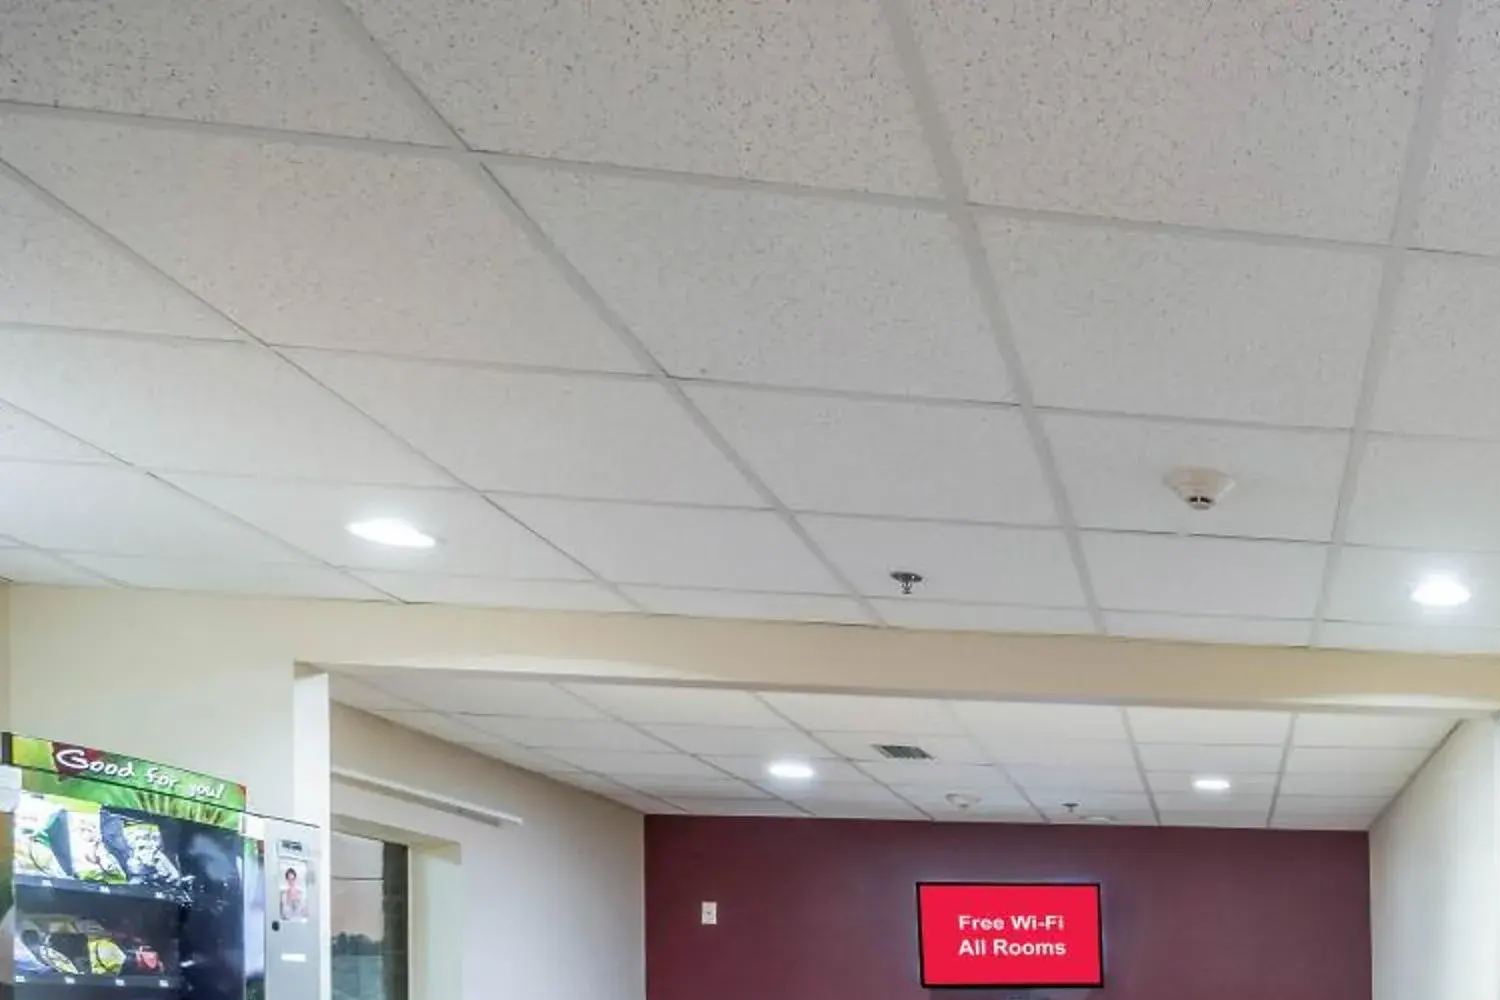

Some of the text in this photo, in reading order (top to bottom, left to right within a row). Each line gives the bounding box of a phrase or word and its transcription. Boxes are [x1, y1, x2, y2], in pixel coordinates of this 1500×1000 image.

[56, 749, 225, 799] Good for you!
[958, 914, 1064, 931] Free Wi-Fi
[958, 938, 1067, 956] All Rooms
